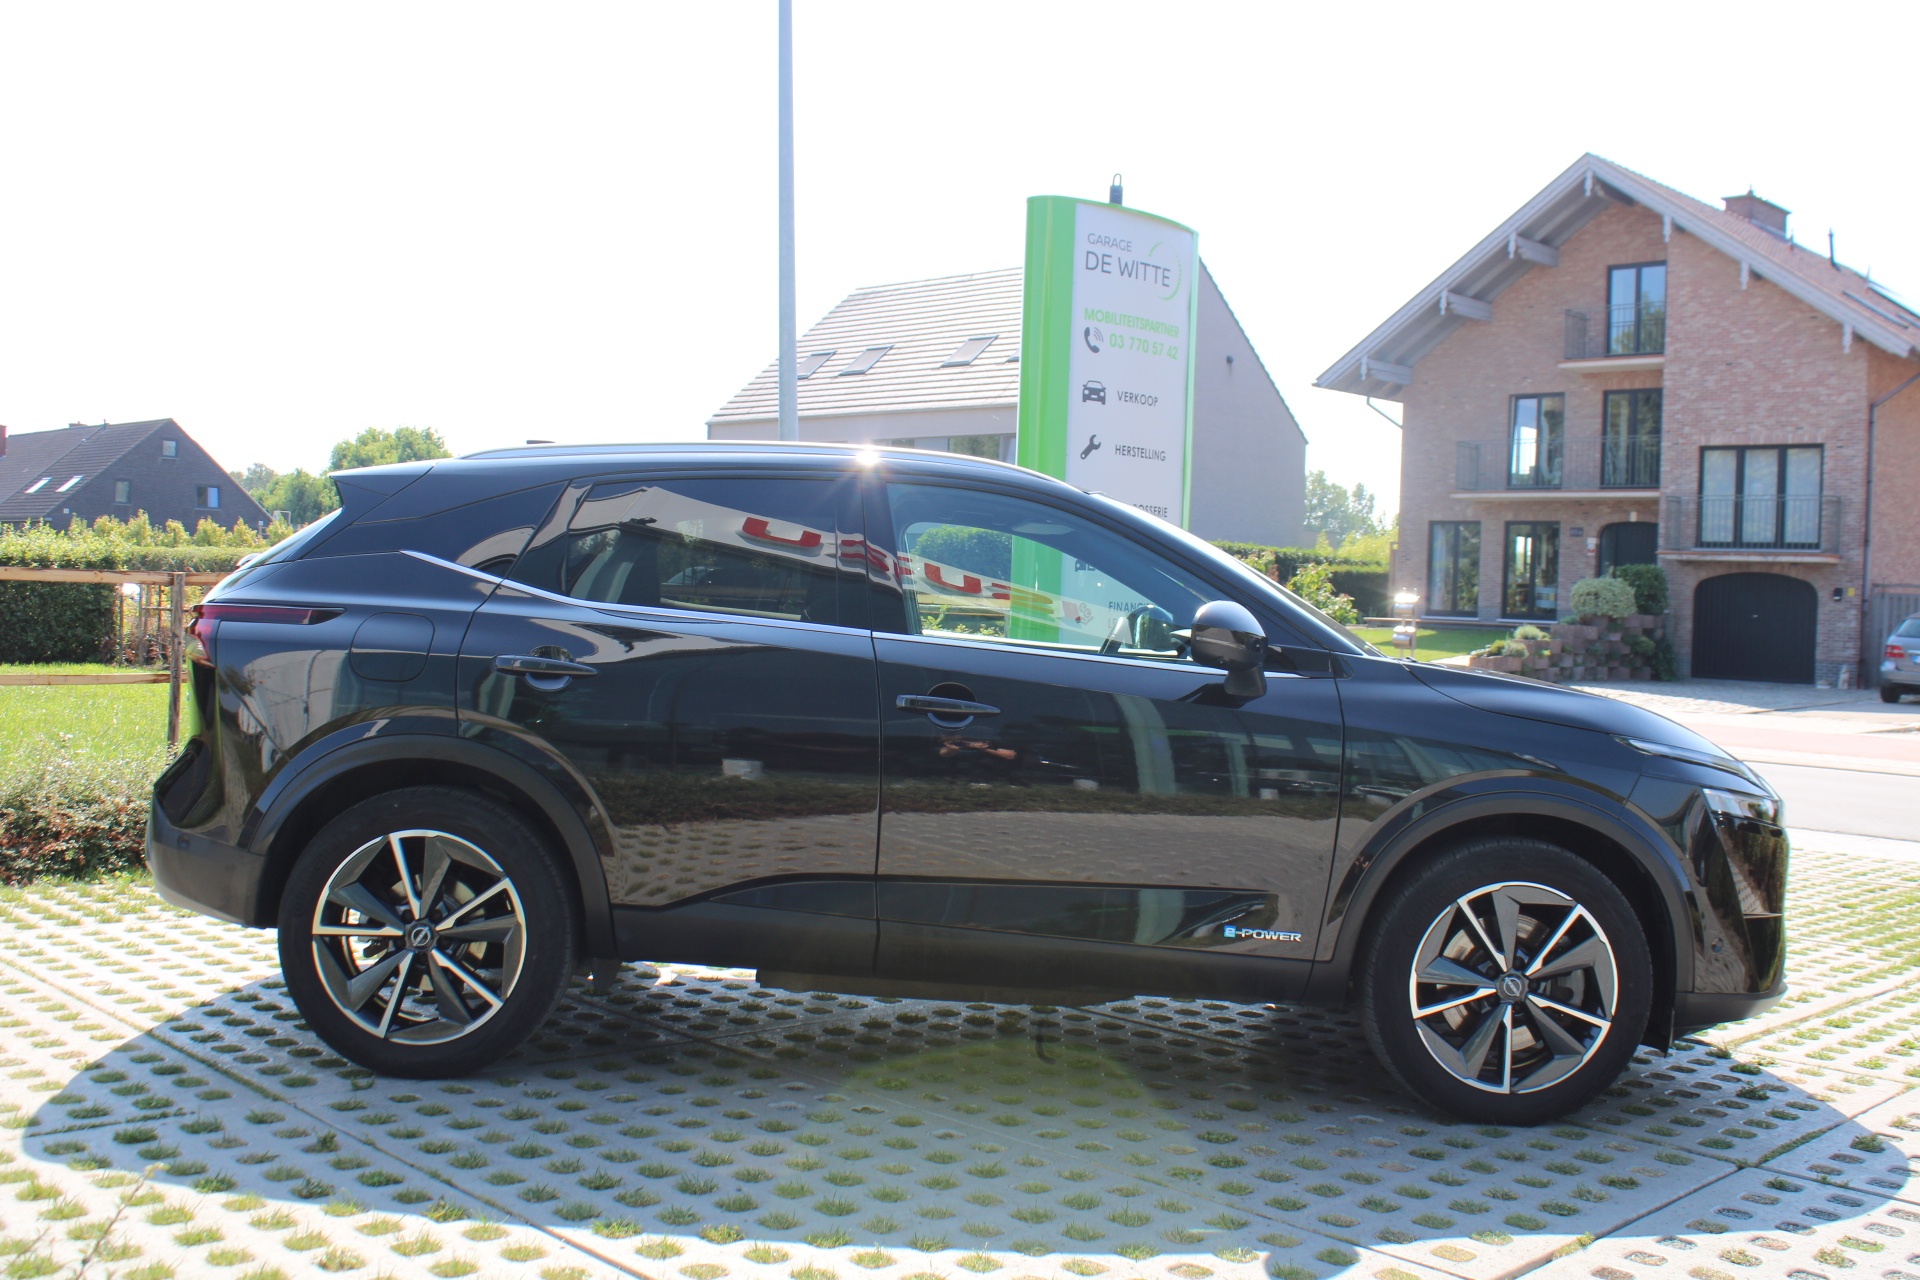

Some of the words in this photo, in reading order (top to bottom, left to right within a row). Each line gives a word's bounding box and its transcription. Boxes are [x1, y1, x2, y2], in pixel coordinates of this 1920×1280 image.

[1087, 233, 1132, 252] GARAGE
[1085, 251, 1112, 274] DE
[1118, 257, 1171, 287] WITTE
[1084, 307, 1179, 338] MOBILITEITSPARTNER
[1109, 333, 1125, 349] 03
[1129, 336, 1149, 353] 770
[1152, 341, 1164, 356] 57
[1166, 345, 1178, 360] 42
[1117, 390, 1158, 406] VERKOOP
[1115, 444, 1166, 461] HERSTELLING
